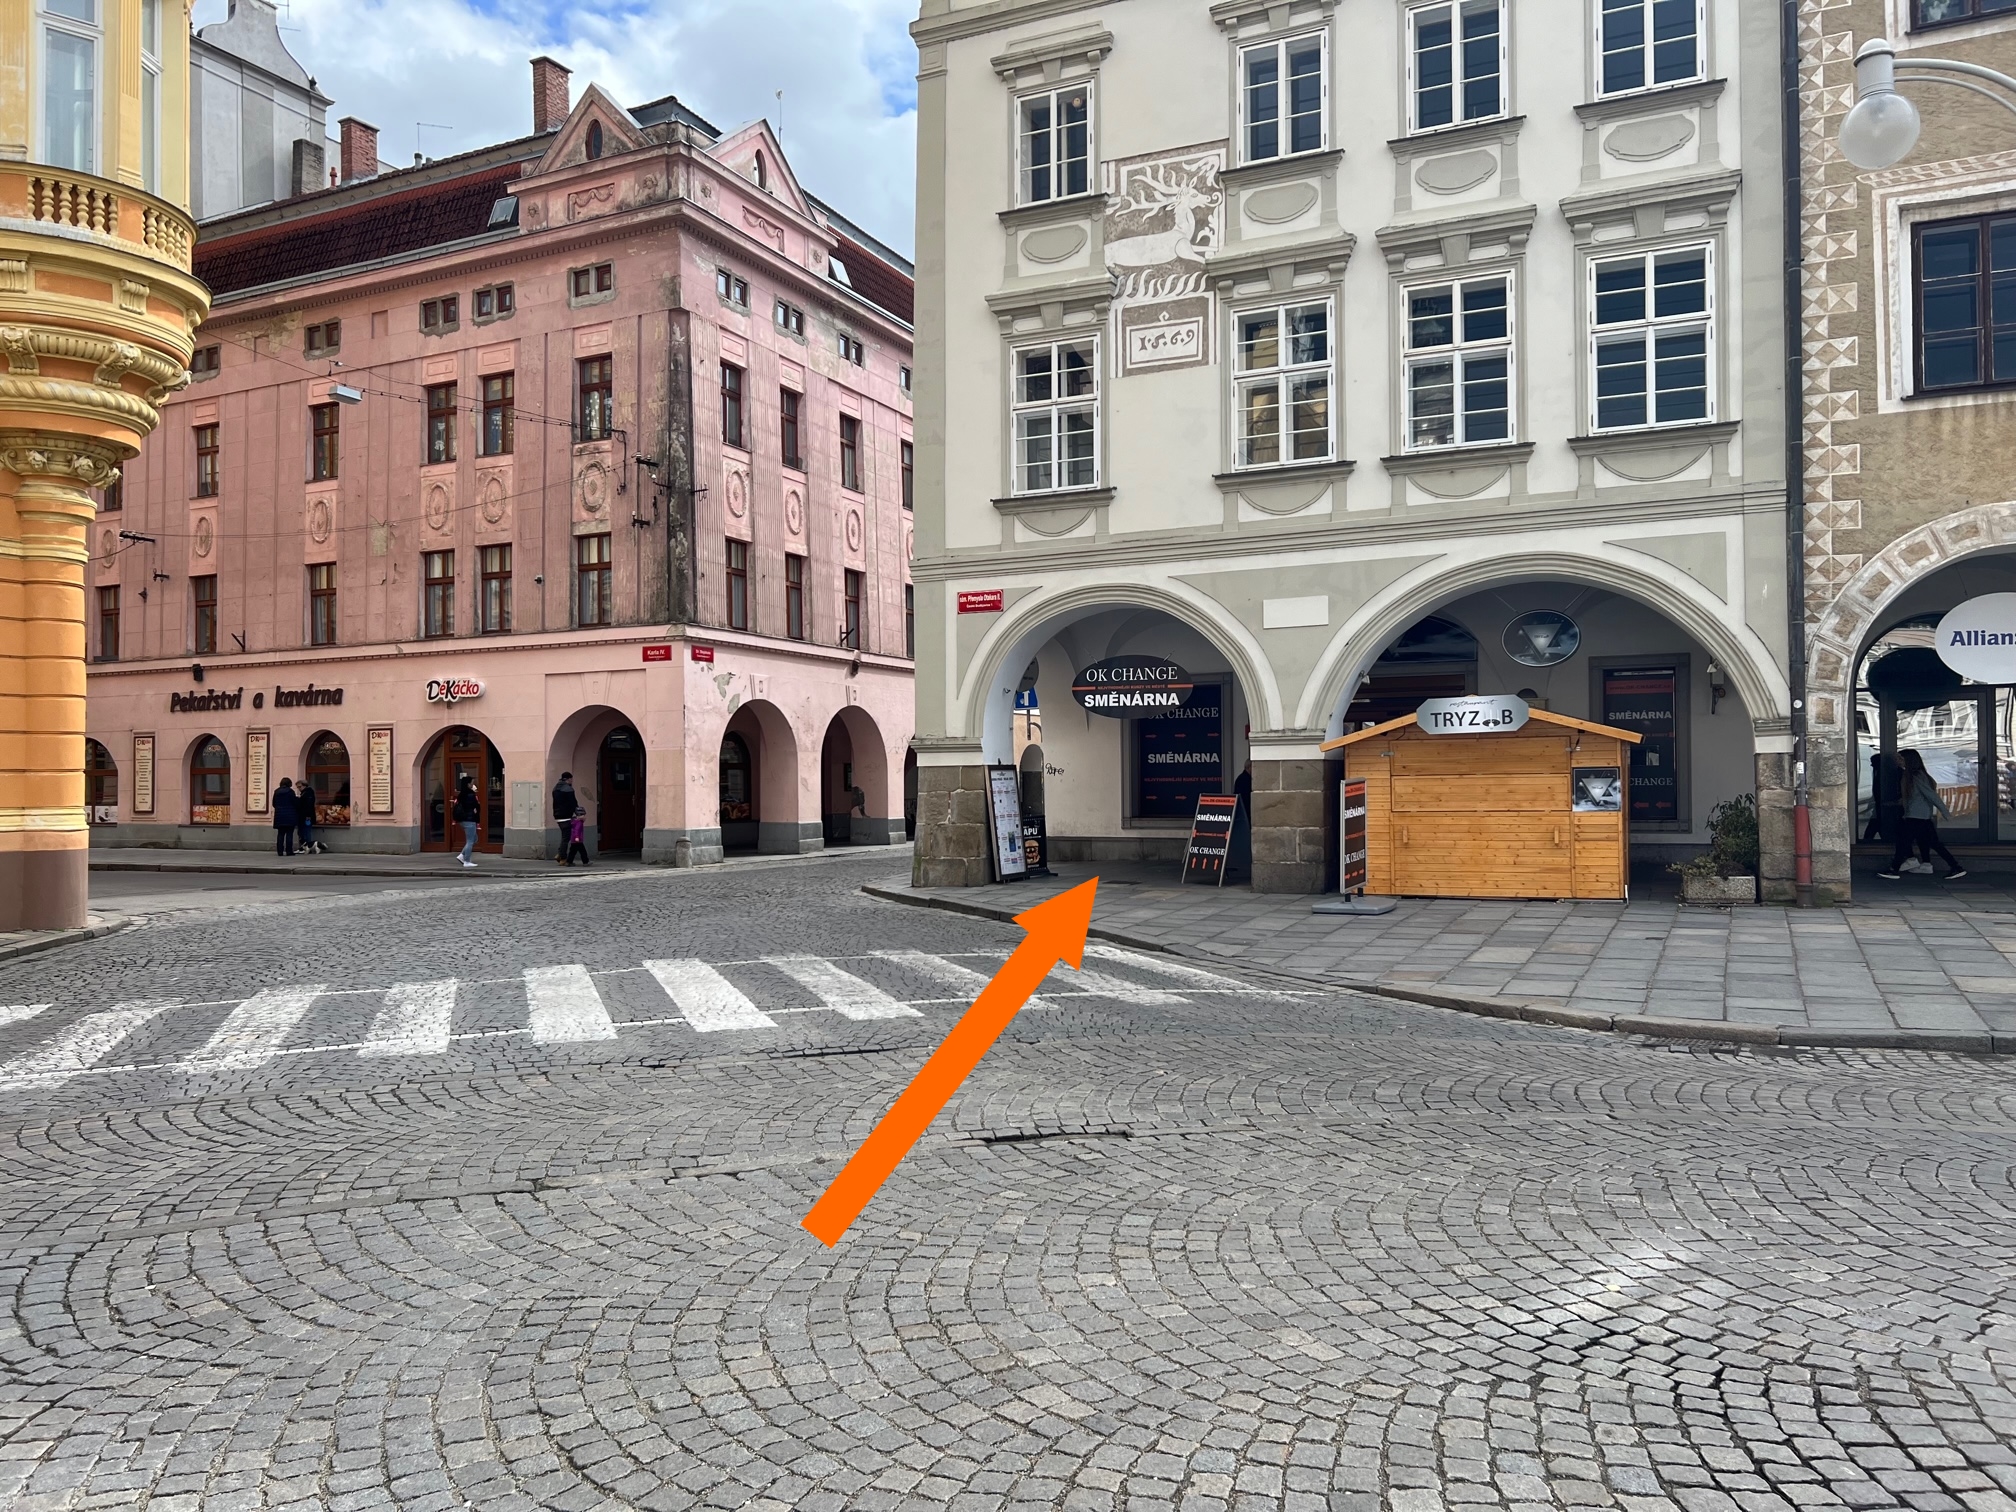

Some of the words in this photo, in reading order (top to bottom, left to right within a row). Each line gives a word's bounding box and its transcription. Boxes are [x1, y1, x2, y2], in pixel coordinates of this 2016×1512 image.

[1950, 630, 2016, 646] Allian
[1086, 668, 1107, 682] OK
[1111, 666, 1178, 682] CHANGE
[426, 680, 480, 700] DéKáčko
[170, 687, 243, 713] Pekařství
[252, 692, 264, 709] a
[274, 683, 343, 708] kavárna
[1084, 690, 1180, 707] SMĚNÁRNA
[1167, 707, 1219, 719] CHANGE
[1608, 710, 1672, 720] SMĚNÁRNA
[1148, 751, 1220, 763] SMĚNÁRNA
[1630, 777, 1673, 786] CHANGE
[1196, 813, 1231, 822] SMĚNÁRNA
[1344, 805, 1365, 819] SMĚNÁRNA
[1189, 846, 1199, 854] OK
[1199, 847, 1225, 856] CHANGE
